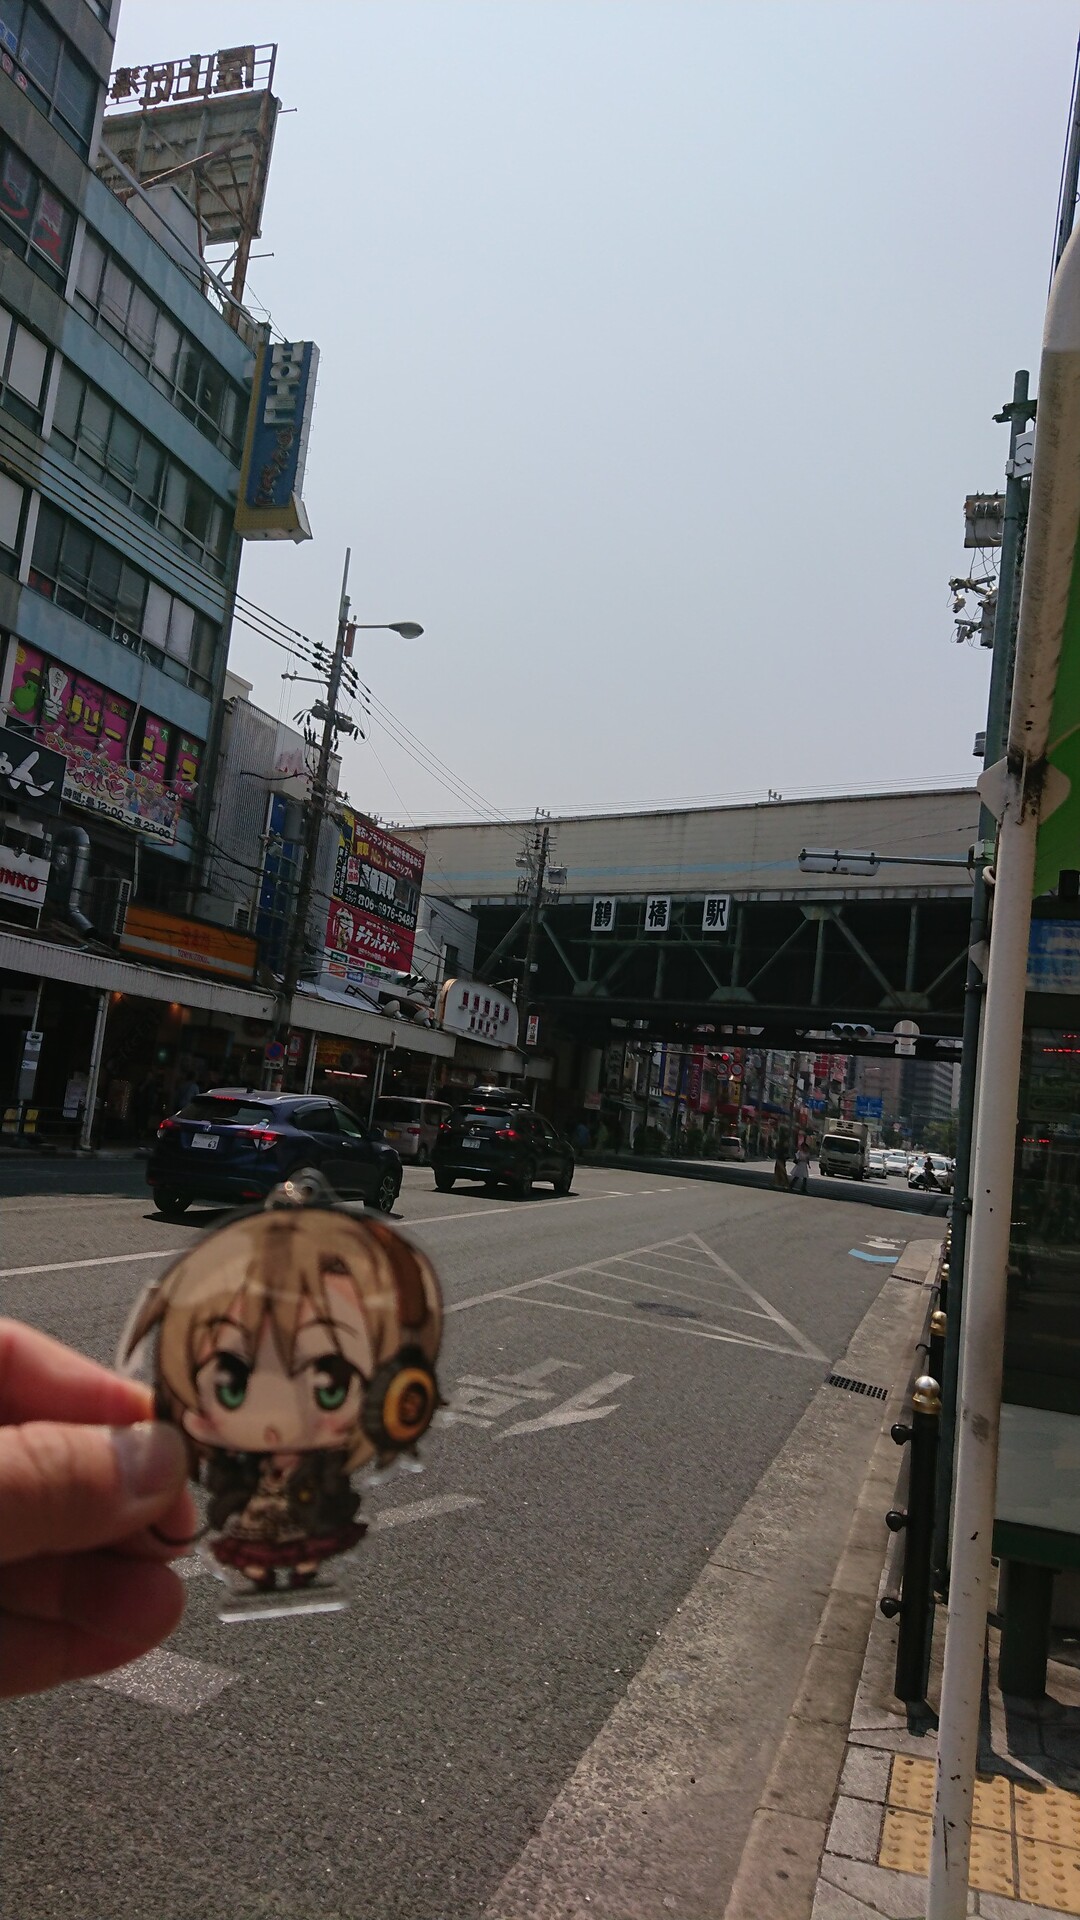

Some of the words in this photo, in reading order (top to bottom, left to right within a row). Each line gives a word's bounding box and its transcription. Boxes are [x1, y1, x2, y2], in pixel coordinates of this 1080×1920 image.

[262, 340, 304, 424] HOTEL
[593, 899, 727, 927] 鶴橋駅
